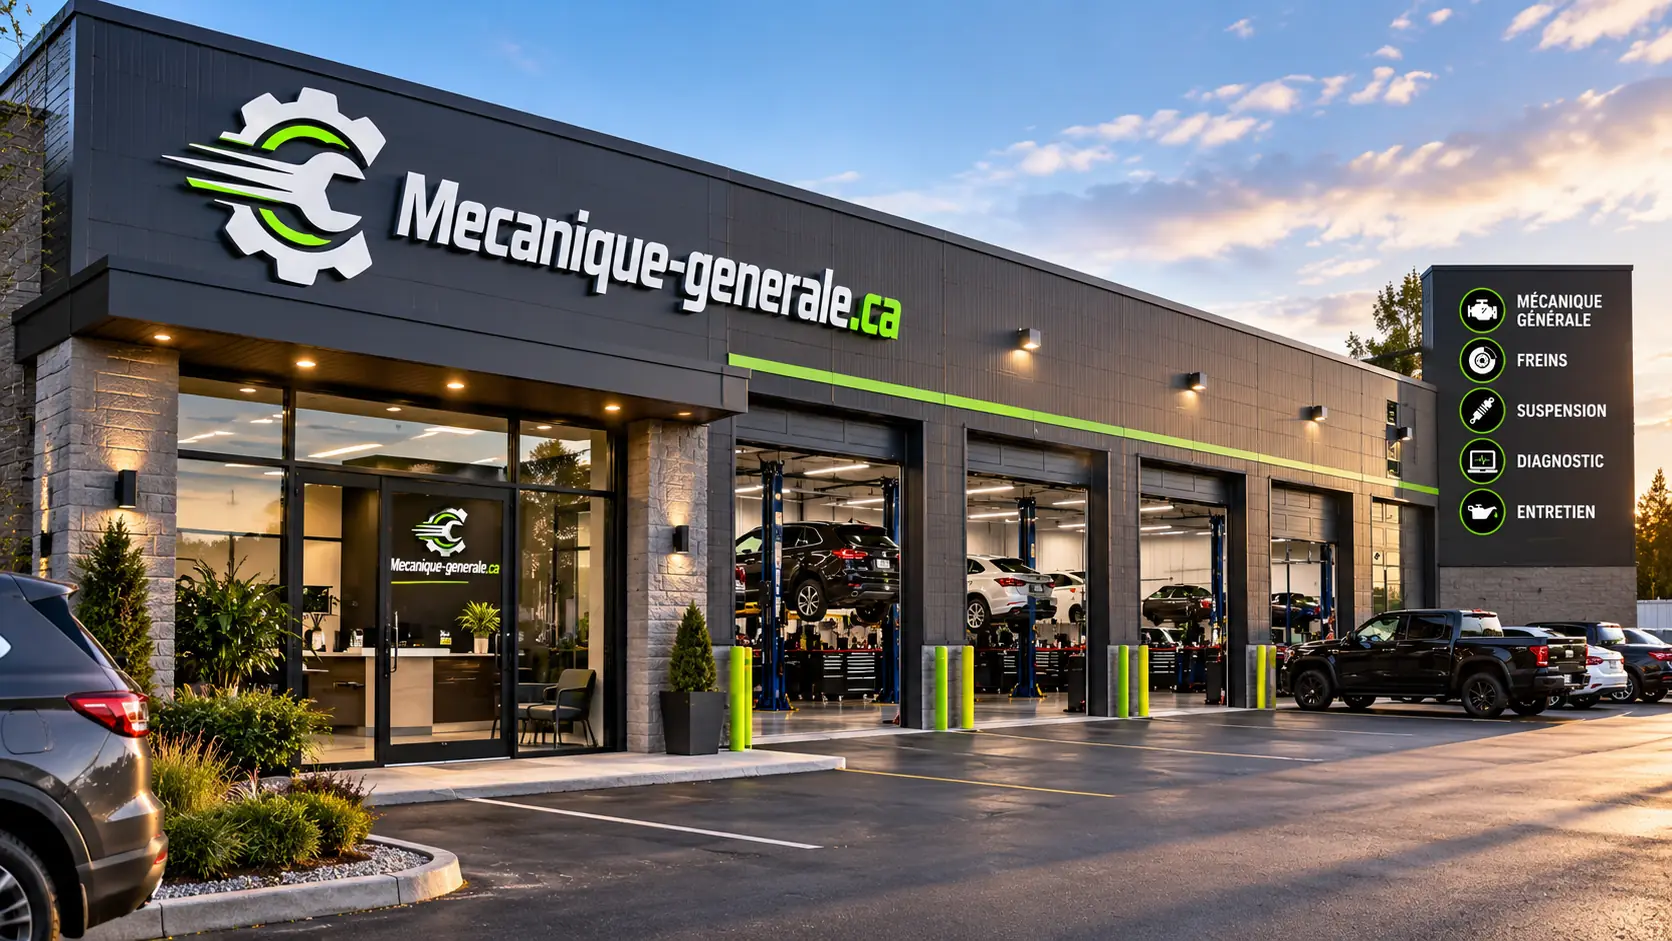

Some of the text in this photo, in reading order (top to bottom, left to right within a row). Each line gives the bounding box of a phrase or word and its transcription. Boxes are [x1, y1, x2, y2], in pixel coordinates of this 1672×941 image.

[396, 171, 902, 340] Mecanique-generale.ca
[1516, 291, 1603, 309] MÉCANIQUE
[1516, 310, 1592, 327] GÉNÉRALE
[1516, 353, 1568, 368] FREINS
[1516, 403, 1607, 418] SUSPENSION
[1516, 453, 1605, 469] DIAGNOSTIC
[1516, 504, 1596, 519] ENTRETIEN
[390, 557, 500, 576] Mecanique-generale.ca
